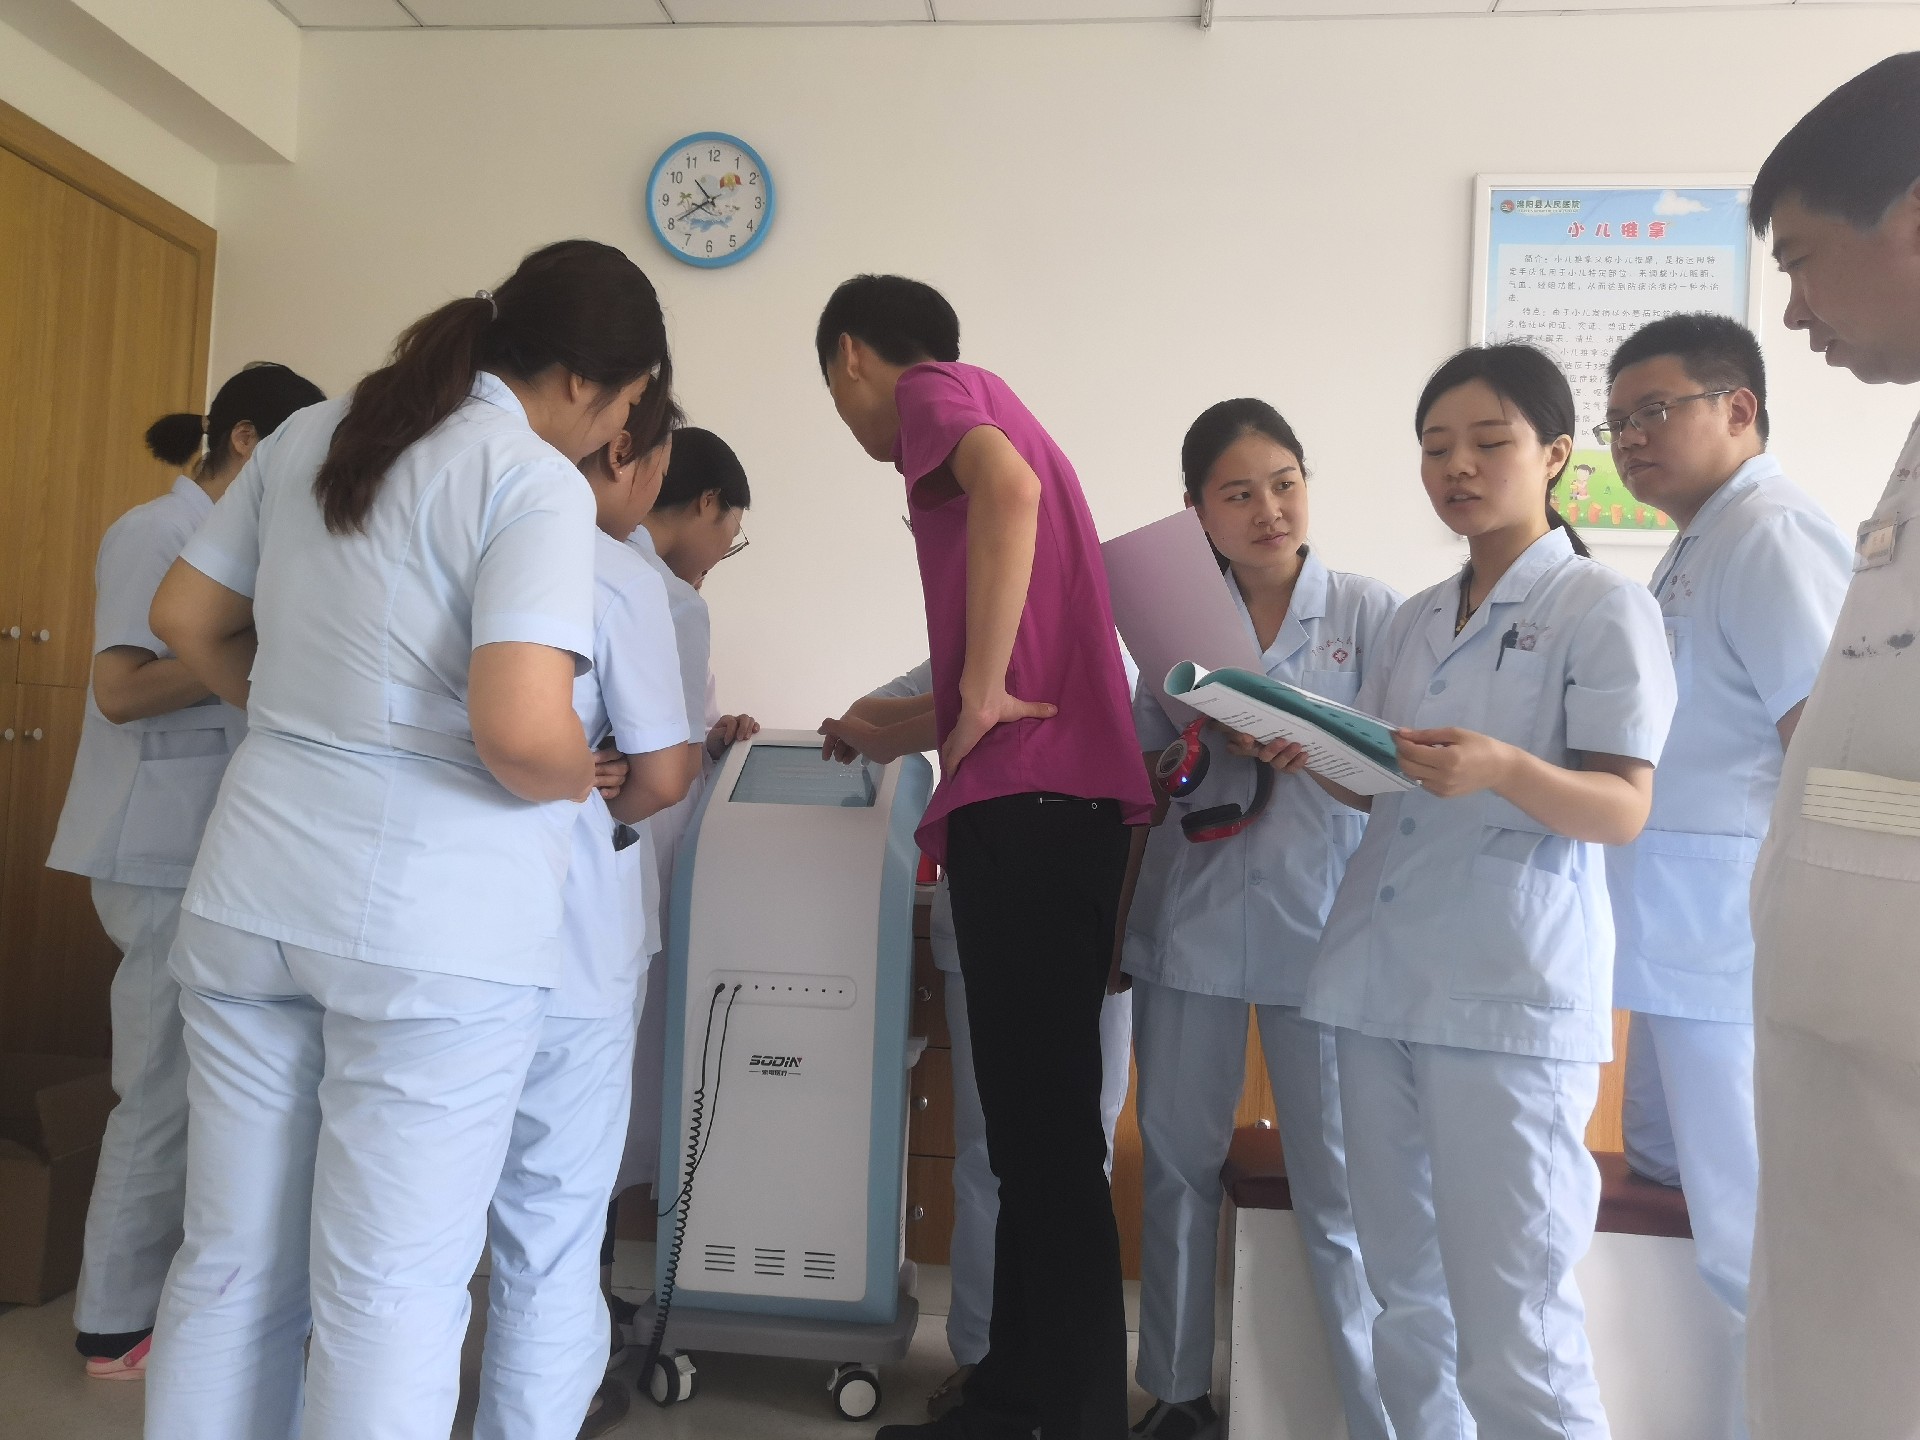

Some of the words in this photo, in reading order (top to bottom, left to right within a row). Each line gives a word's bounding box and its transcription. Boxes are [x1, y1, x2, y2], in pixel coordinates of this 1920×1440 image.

[708, 149, 720, 162] 12
[686, 156, 697, 169] 11
[734, 157, 740, 170] 1
[670, 171, 683, 184] 10
[748, 172, 757, 185] 2
[662, 193, 670, 206] 9
[754, 196, 762, 209] 3
[667, 217, 675, 230] 8
[746, 219, 753, 232] 4
[1567, 221, 1667, 239] 小儿推拿
[684, 233, 692, 246] 7
[705, 239, 713, 253] 6
[729, 234, 737, 247] 5
